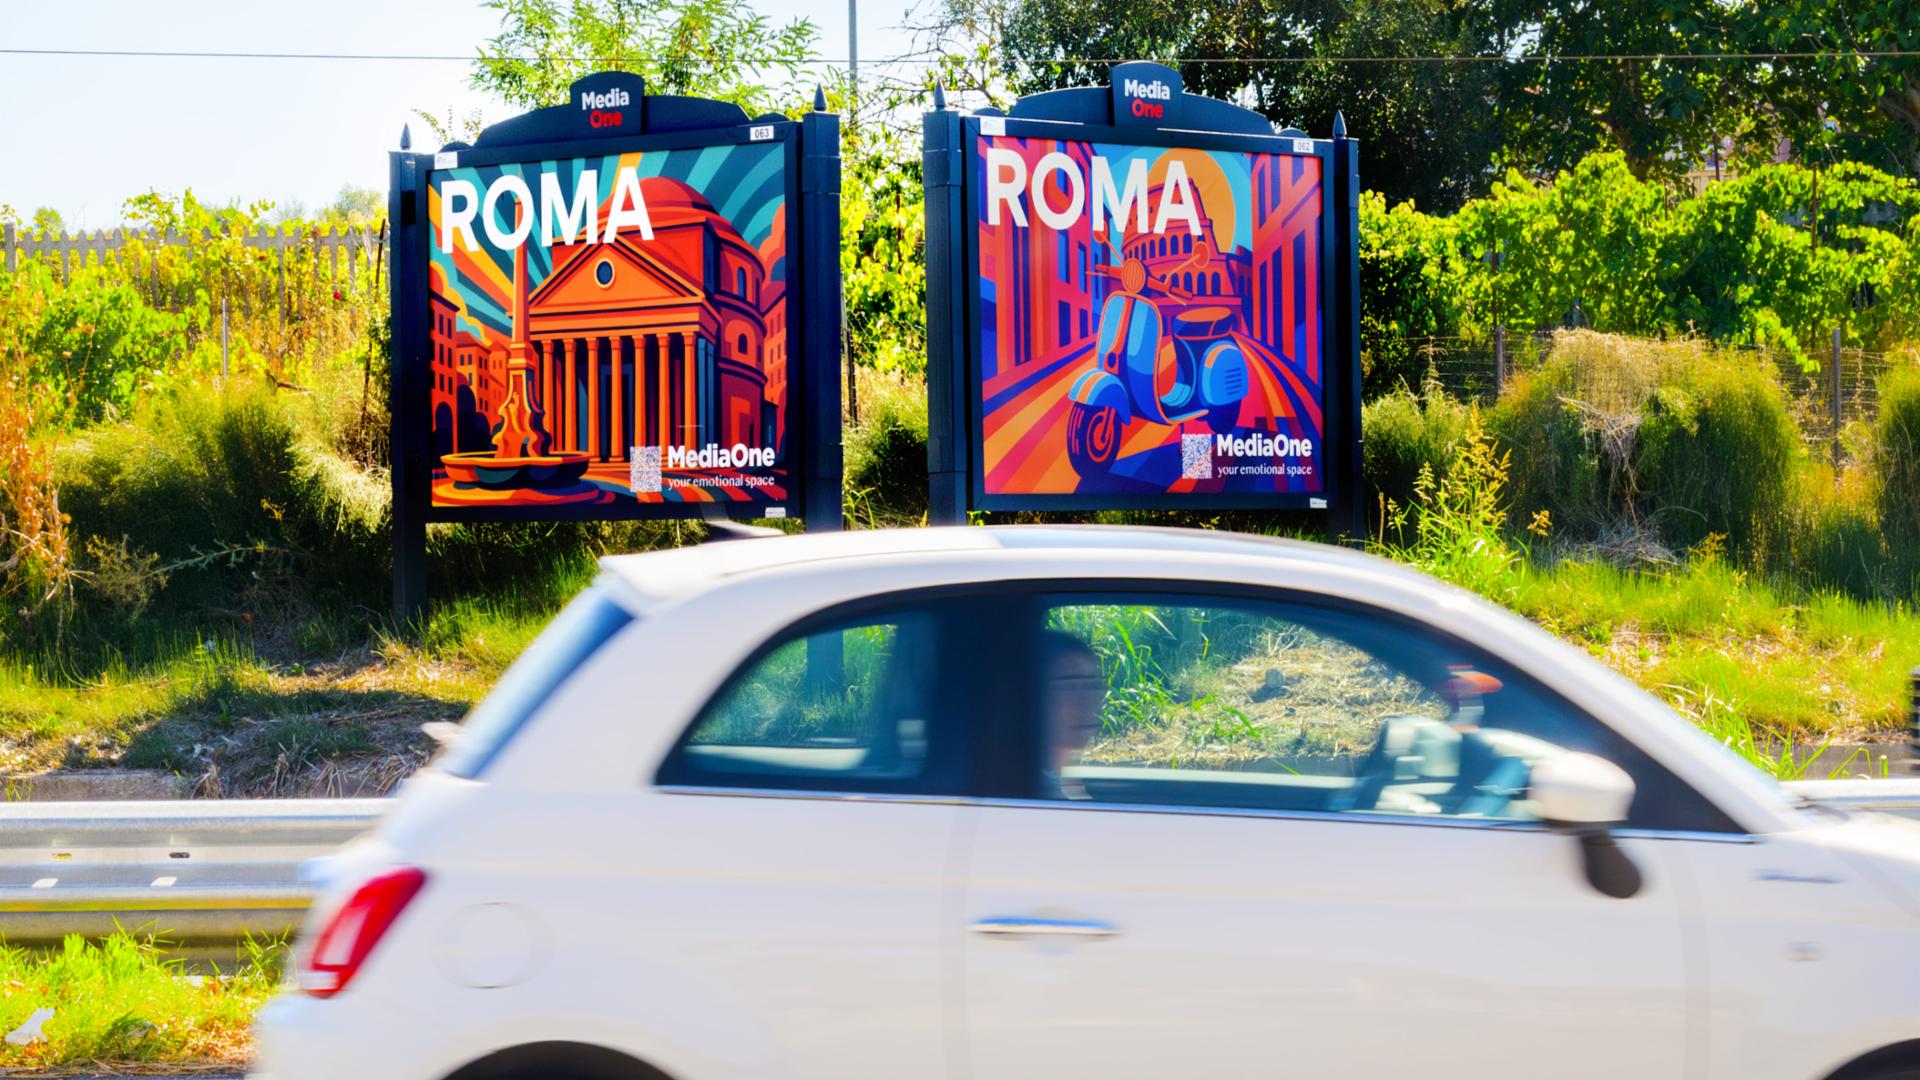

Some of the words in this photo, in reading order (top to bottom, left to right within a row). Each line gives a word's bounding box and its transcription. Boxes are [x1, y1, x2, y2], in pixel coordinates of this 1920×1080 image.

[581, 87, 630, 111] Media
[1124, 78, 1171, 100] Media
[589, 109, 623, 129] One
[1131, 98, 1164, 119] One
[754, 128, 770, 138] 063
[986, 147, 1202, 236] ROMA
[440, 166, 655, 254] ROMA
[667, 442, 776, 469] MediaOne
[1216, 432, 1313, 457] MediaOne
[1217, 464, 1239, 478] your
[1239, 462, 1285, 475] emotional
[1286, 465, 1313, 478] space
[668, 477, 691, 491] your
[692, 474, 744, 487] emotional
[745, 475, 775, 489] space
